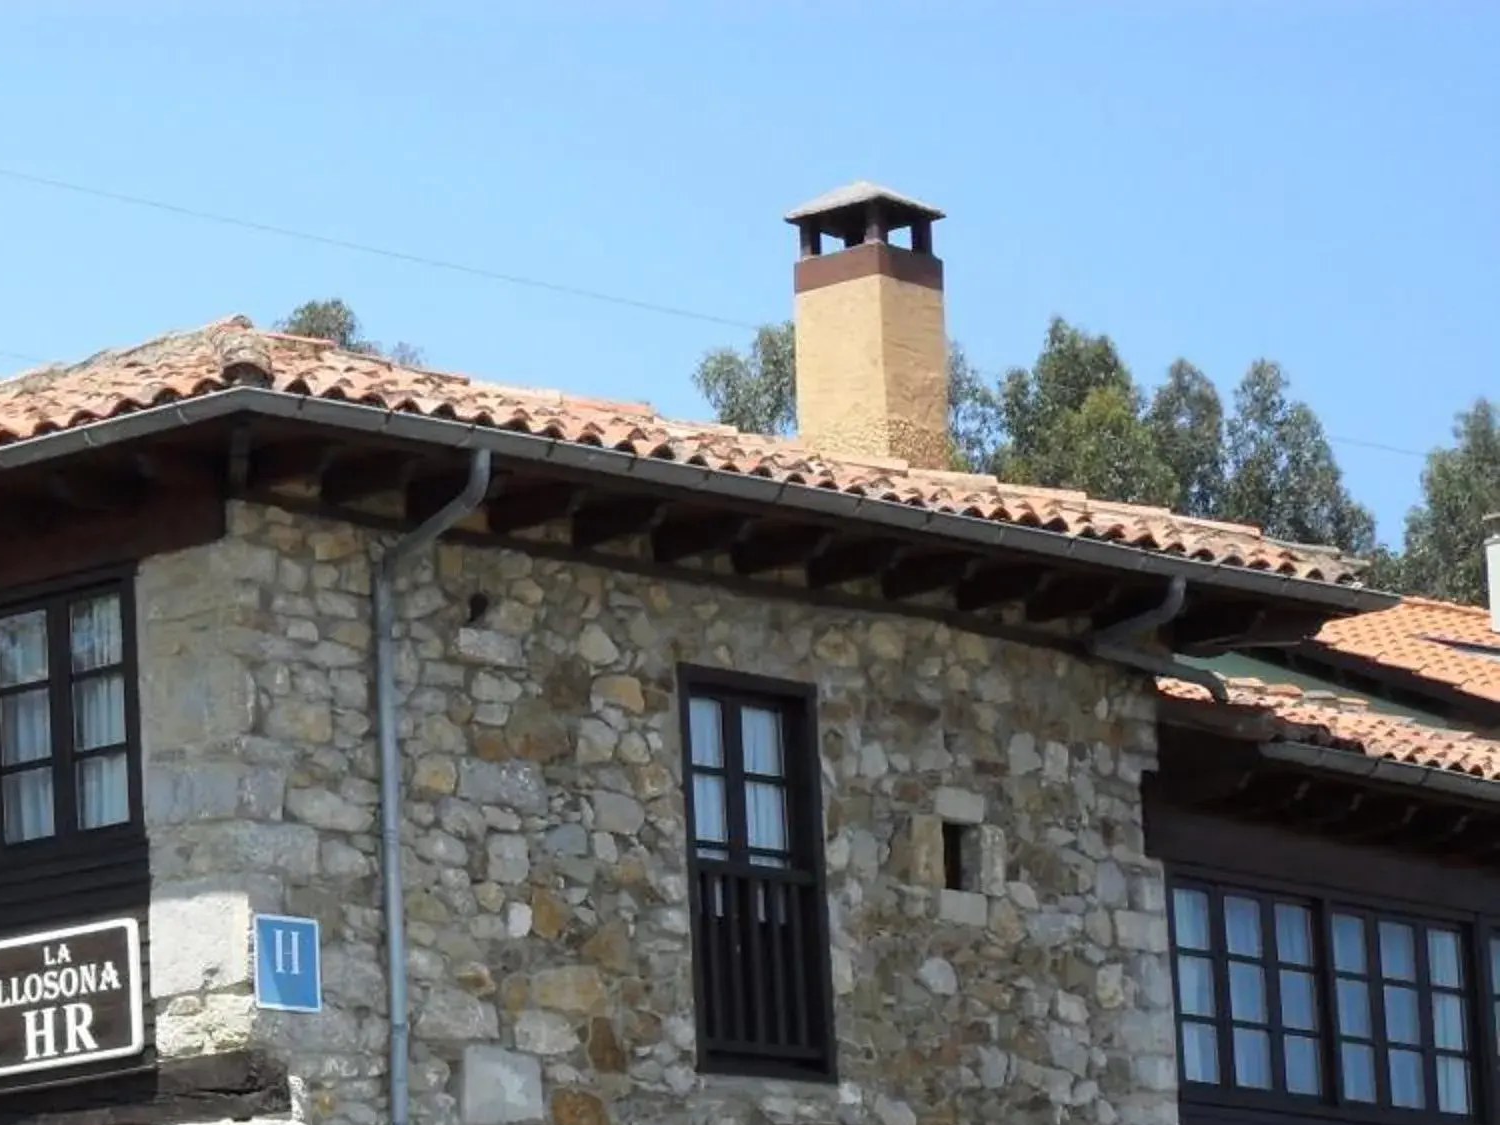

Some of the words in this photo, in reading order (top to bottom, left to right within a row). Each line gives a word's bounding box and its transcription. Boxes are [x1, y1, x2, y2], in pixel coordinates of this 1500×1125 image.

[43, 942, 72, 966] LA
[273, 928, 301, 975] H
[23, 1002, 99, 1061] HR
